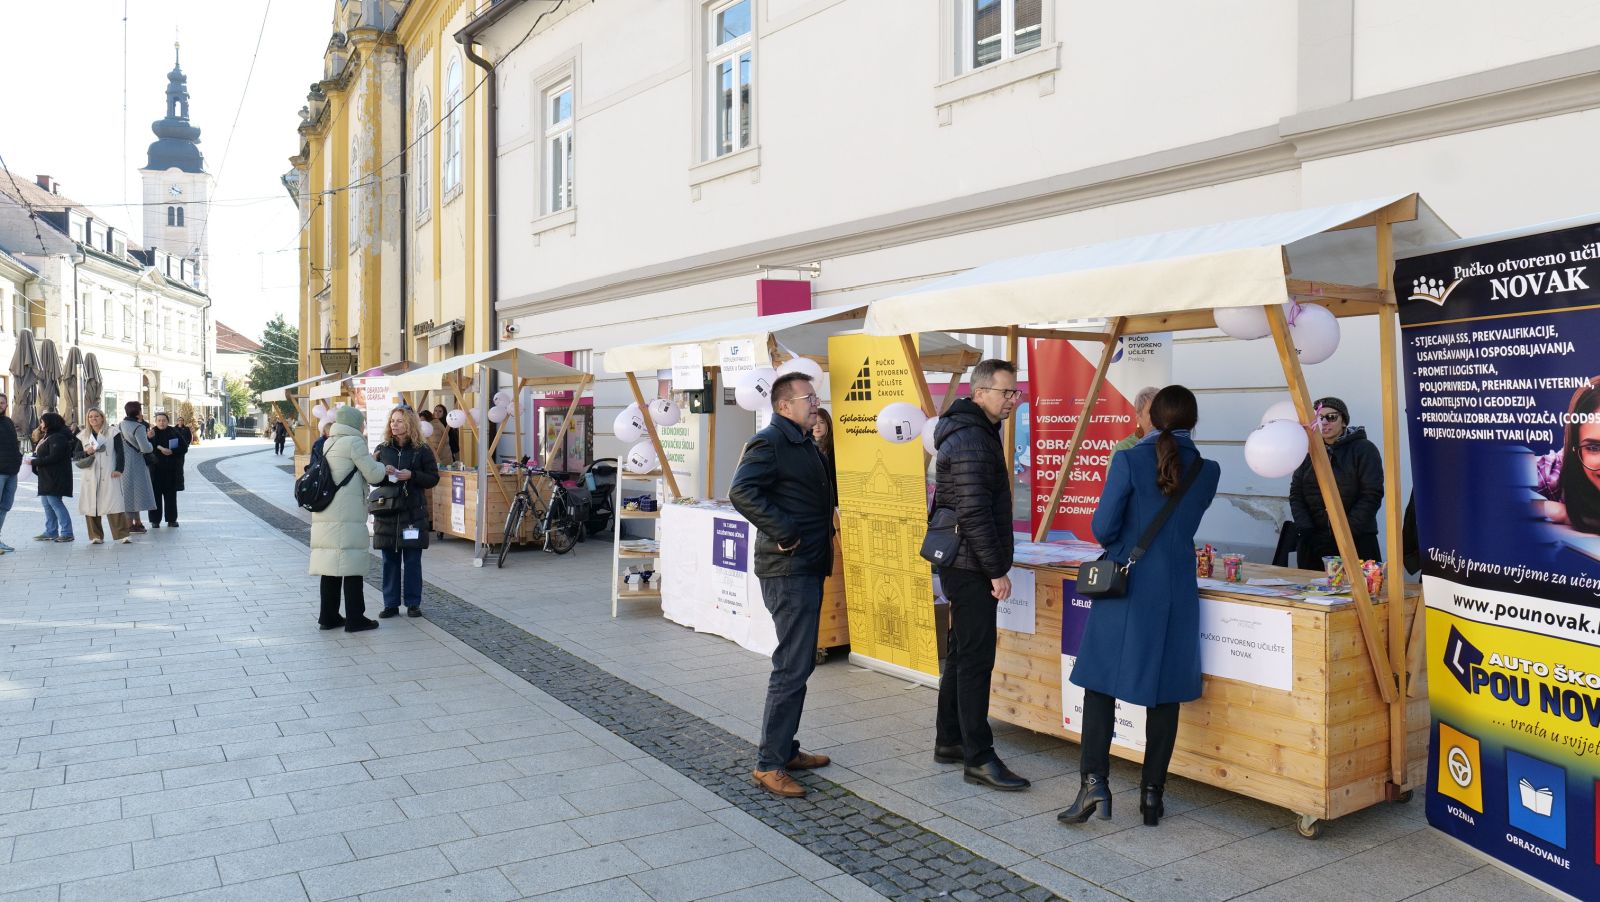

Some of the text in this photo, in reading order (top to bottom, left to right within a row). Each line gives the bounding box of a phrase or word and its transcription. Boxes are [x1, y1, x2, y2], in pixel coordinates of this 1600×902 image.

[1454, 262, 1494, 279] Pučko
[1497, 252, 1566, 273] otvoreno
[1490, 266, 1589, 300] NOVAK
[1415, 334, 1455, 348] STJECANJA
[1456, 332, 1471, 344] SSS,
[1472, 325, 1558, 342] PREKVALIFIKACIJE,
[1417, 341, 1575, 361] USAVRŠAVANJA I OSPOSOBLJAVANJA
[1418, 366, 1448, 377] PROMET
[1452, 363, 1498, 376] LOGISTIKA,
[877, 378, 903, 387] UČILIŠTE
[1420, 381, 1480, 393] POLJOPRIVREDA,
[1482, 379, 1532, 391] PREHRANA
[1539, 376, 1595, 390] VETERINA,
[878, 389, 904, 397] ČAKOVEC
[1420, 396, 1477, 409] GRADITELJSTVO
[1484, 396, 1536, 409] GEODEZIJA
[1036, 415, 1131, 423] VISOKOKLITETNO
[1422, 410, 1463, 423] PERIODIČKA
[1464, 412, 1515, 423] IZOBRAZBA
[1516, 410, 1557, 424] VOZAČA
[1559, 411, 1600, 427] (COD95
[1036, 439, 1119, 450] OBRAOVAN
[1423, 428, 1553, 444] PRIJEVOZ OPASNIH TVARI (ADR)
[1036, 494, 1100, 504] POZNICIMA
[1427, 547, 1456, 569] Uvijek
[1454, 556, 1465, 573] je
[1466, 558, 1500, 578] pravo
[1503, 564, 1549, 584] vrijeme
[1551, 572, 1567, 585] za
[1200, 632, 1285, 654] PUČKO OTVORENO UČILIŠTE
[1230, 649, 1252, 659] NOVAK
[1489, 653, 1600, 690] AUTO ŠKO
[1472, 665, 1531, 707] POU
[1510, 718, 1548, 739] vrata
[1551, 732, 1559, 742] u
[1447, 804, 1475, 826] VOŽNJA
[1506, 832, 1570, 870] OBRAZOVANJE
